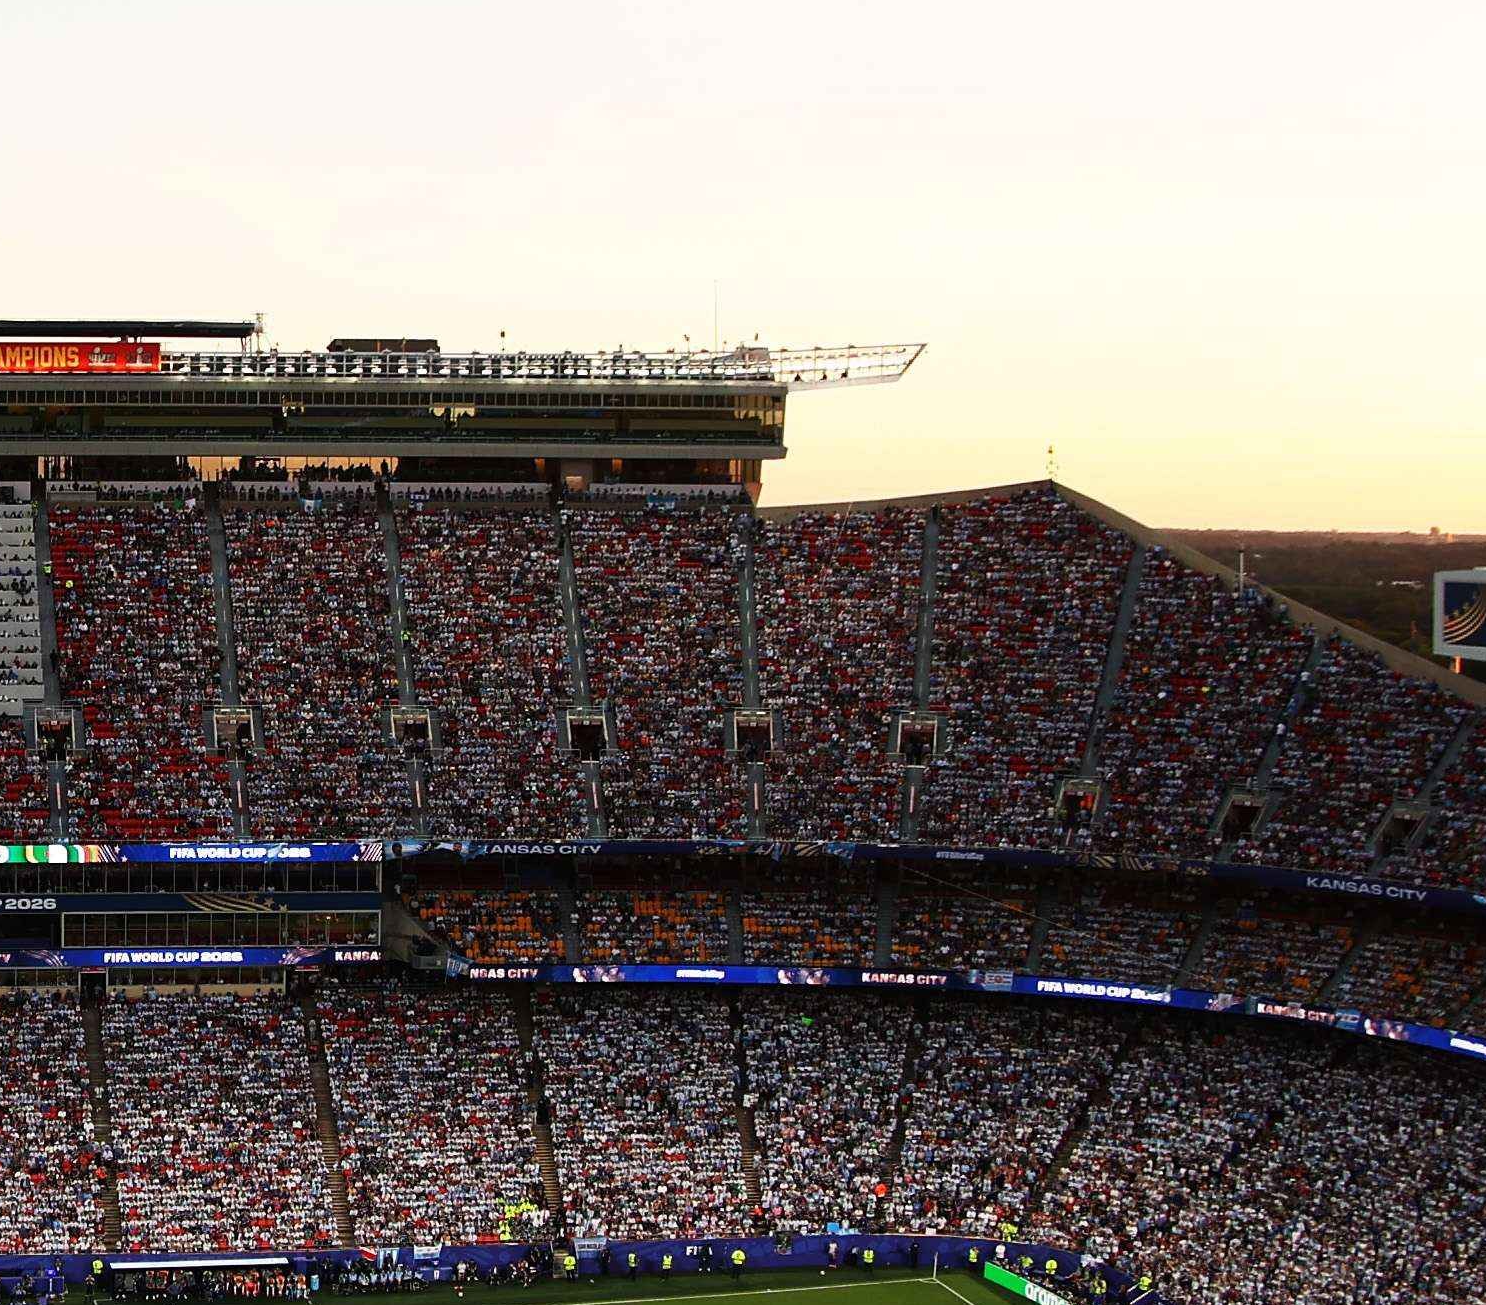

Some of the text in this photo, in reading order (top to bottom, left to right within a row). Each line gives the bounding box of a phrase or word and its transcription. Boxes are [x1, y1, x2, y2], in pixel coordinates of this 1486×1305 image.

[170, 847, 195, 859] FIFA
[198, 847, 241, 859] WORLD
[243, 847, 266, 859] CUP
[485, 845, 555, 854] ANSAS
[1307, 876, 1427, 901] KANSAS CITY
[5, 898, 57, 910] 2026
[104, 952, 129, 964] FIFA
[131, 952, 174, 963] WORLD
[176, 952, 199, 963] CUP
[507, 968, 539, 979] CITY
[862, 972, 947, 985] KANSAS CITY
[1037, 981, 1066, 995] FIFA
[1067, 982, 1109, 997] WORLD
[1109, 985, 1131, 999] CUP
